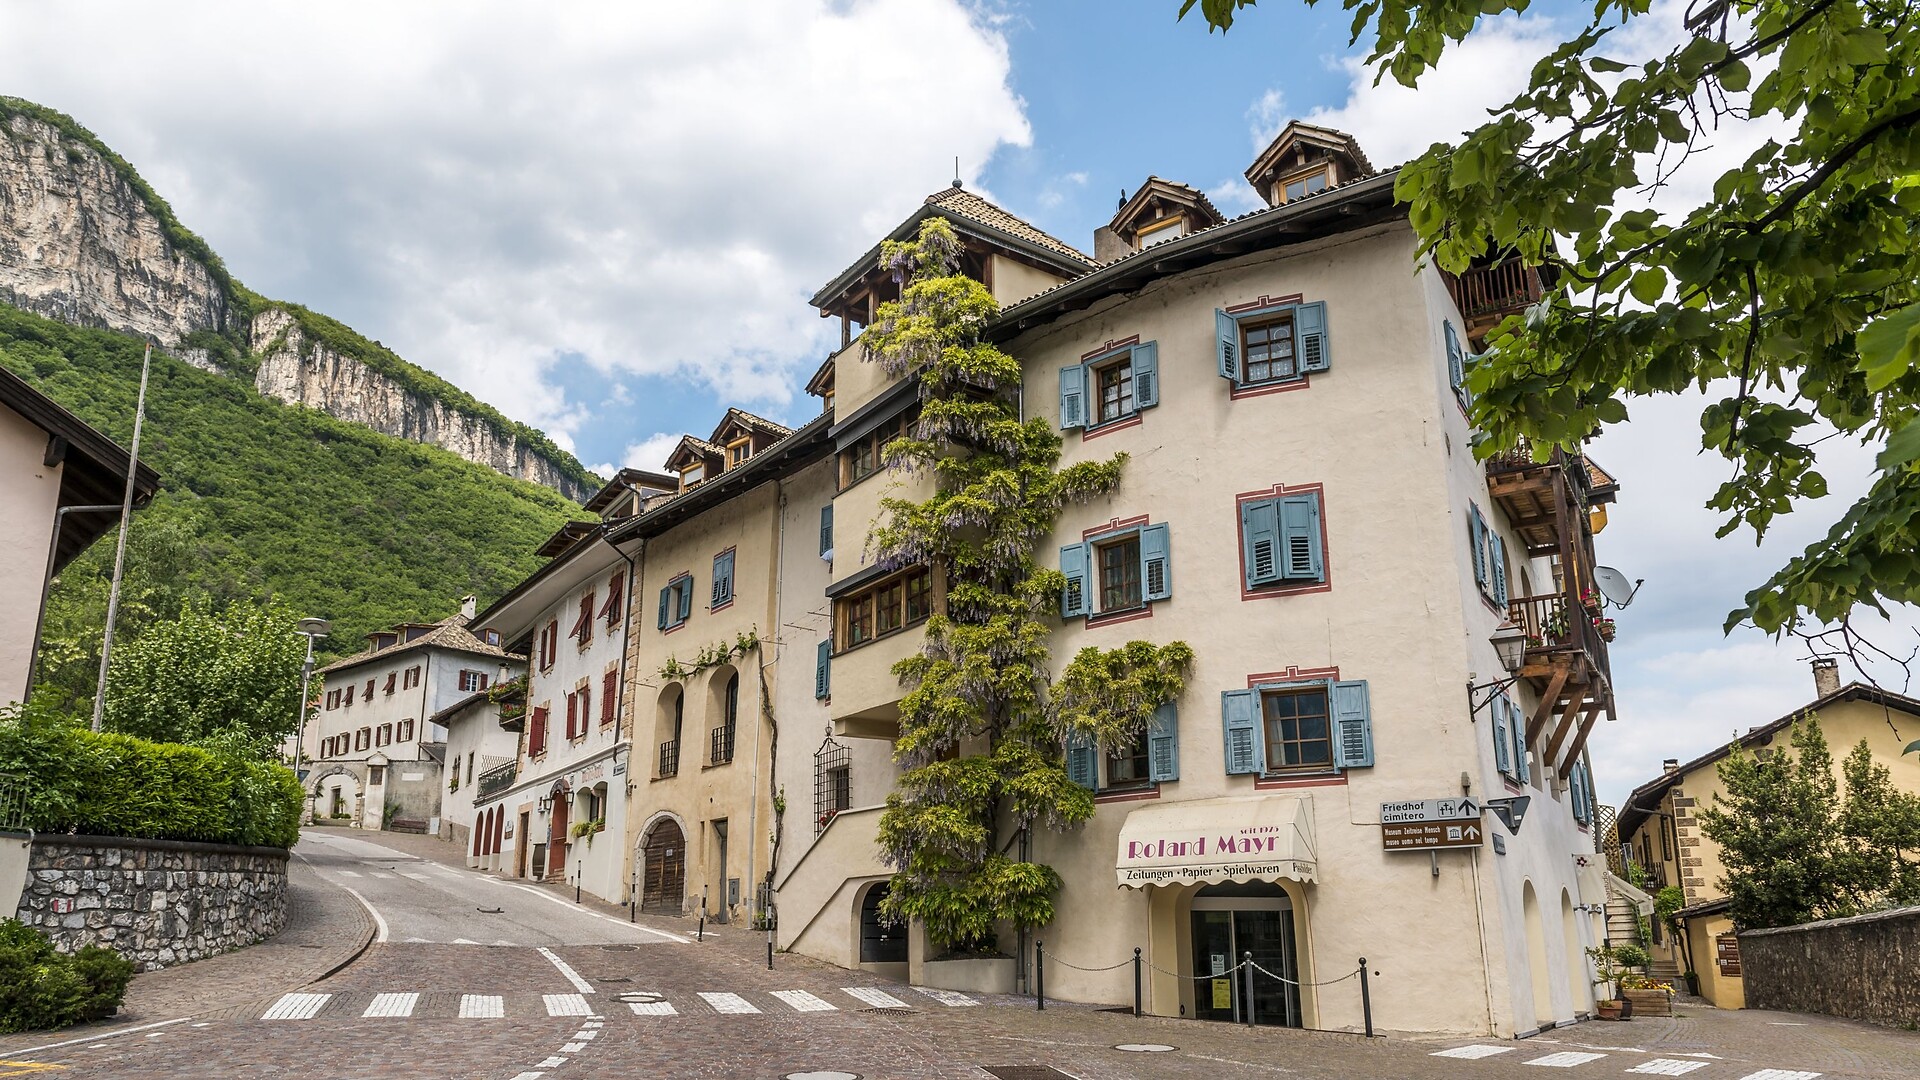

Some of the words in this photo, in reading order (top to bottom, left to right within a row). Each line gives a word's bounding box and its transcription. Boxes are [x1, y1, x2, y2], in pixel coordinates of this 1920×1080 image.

[1382, 802, 1425, 812] Friedhof
[1383, 812, 1425, 821] cimitero
[1384, 828, 1402, 836] Museum
[1424, 826, 1441, 834] Mensch
[1424, 837, 1439, 845] tempo
[1128, 837, 1205, 858] Roland
[1216, 835, 1279, 855] Mayr
[1126, 869, 1174, 881] Zeitungen
[1182, 866, 1213, 880] Papier
[1223, 864, 1279, 878] Spielwaren
